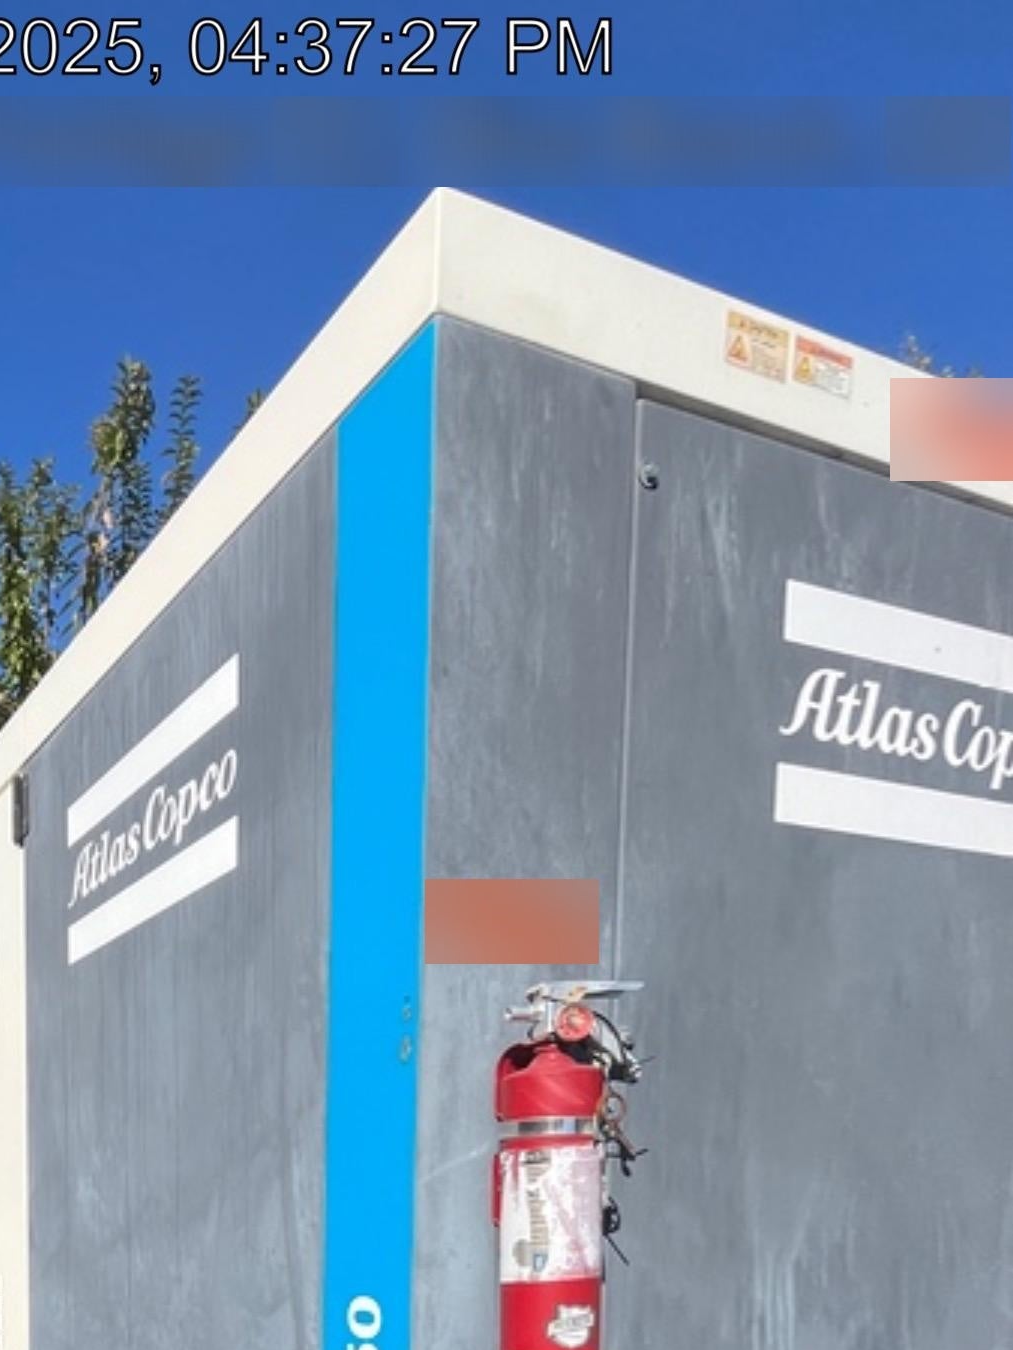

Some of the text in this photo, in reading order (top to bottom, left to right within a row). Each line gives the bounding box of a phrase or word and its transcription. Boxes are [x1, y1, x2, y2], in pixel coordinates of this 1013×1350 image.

[779, 668, 940, 761] Atlas
[68, 748, 238, 910] Atlas Copco
